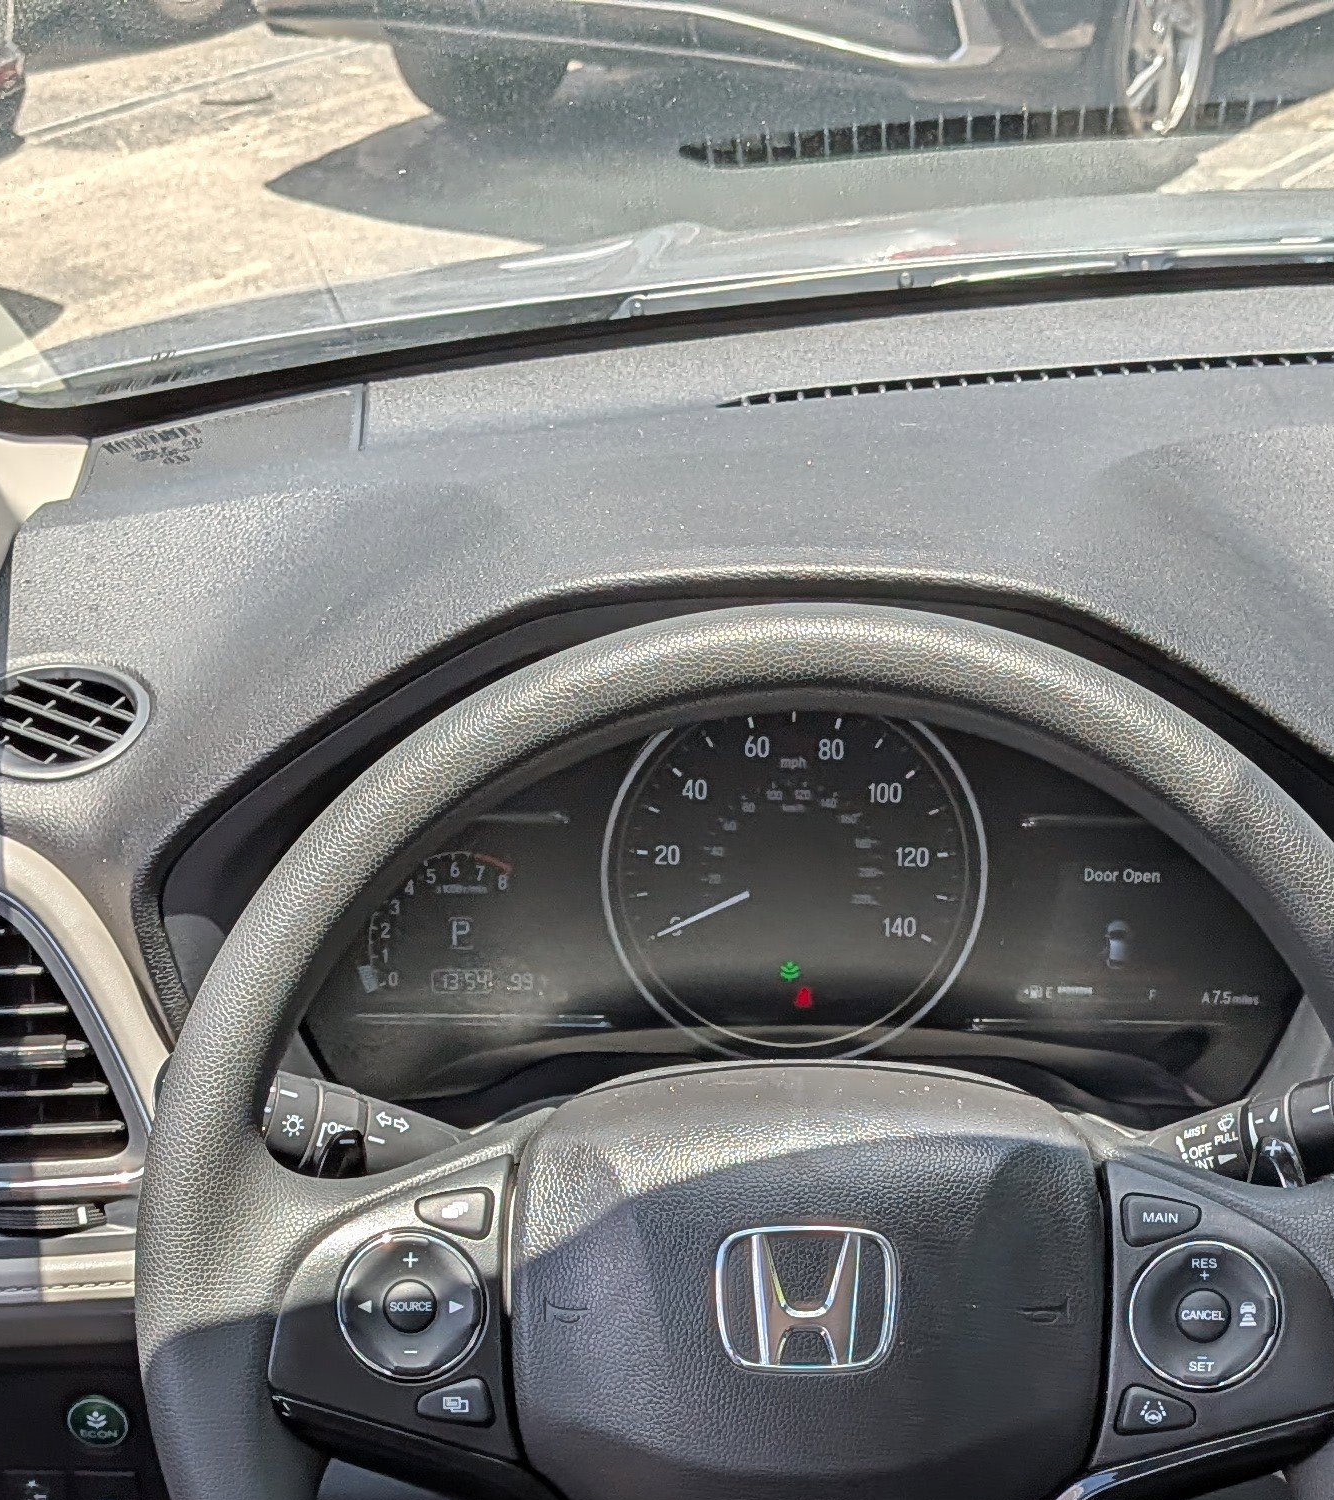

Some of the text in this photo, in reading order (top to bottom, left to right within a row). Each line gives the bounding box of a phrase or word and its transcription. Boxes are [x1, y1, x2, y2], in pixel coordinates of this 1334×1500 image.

[744, 736, 770, 759] 60
[818, 738, 844, 761] 80
[780, 756, 807, 771] mph
[682, 779, 707, 800] 40
[868, 782, 902, 804] 100
[655, 845, 681, 866] 20
[896, 847, 929, 869] 120
[426, 869, 436, 884] 5
[450, 861, 460, 878] 6
[475, 865, 485, 881] 7
[1084, 867, 1161, 885] Door Open
[404, 879, 415, 896] 4
[498, 874, 508, 891] 8
[389, 899, 400, 915] 3
[380, 923, 391, 939] 2
[451, 920, 471, 947] P
[883, 916, 917, 938] 140
[1183, 1124, 1208, 1140] MIST
[1214, 1131, 1239, 1146] PULL
[1189, 1141, 1213, 1161] OFF
[1142, 1211, 1179, 1224] MAIN
[1190, 1257, 1218, 1270] RES
[389, 1301, 432, 1312] SOURCE
[1180, 1309, 1226, 1322] CANCEL
[1188, 1360, 1215, 1373] SET
[79, 1428, 121, 1440] ECON
